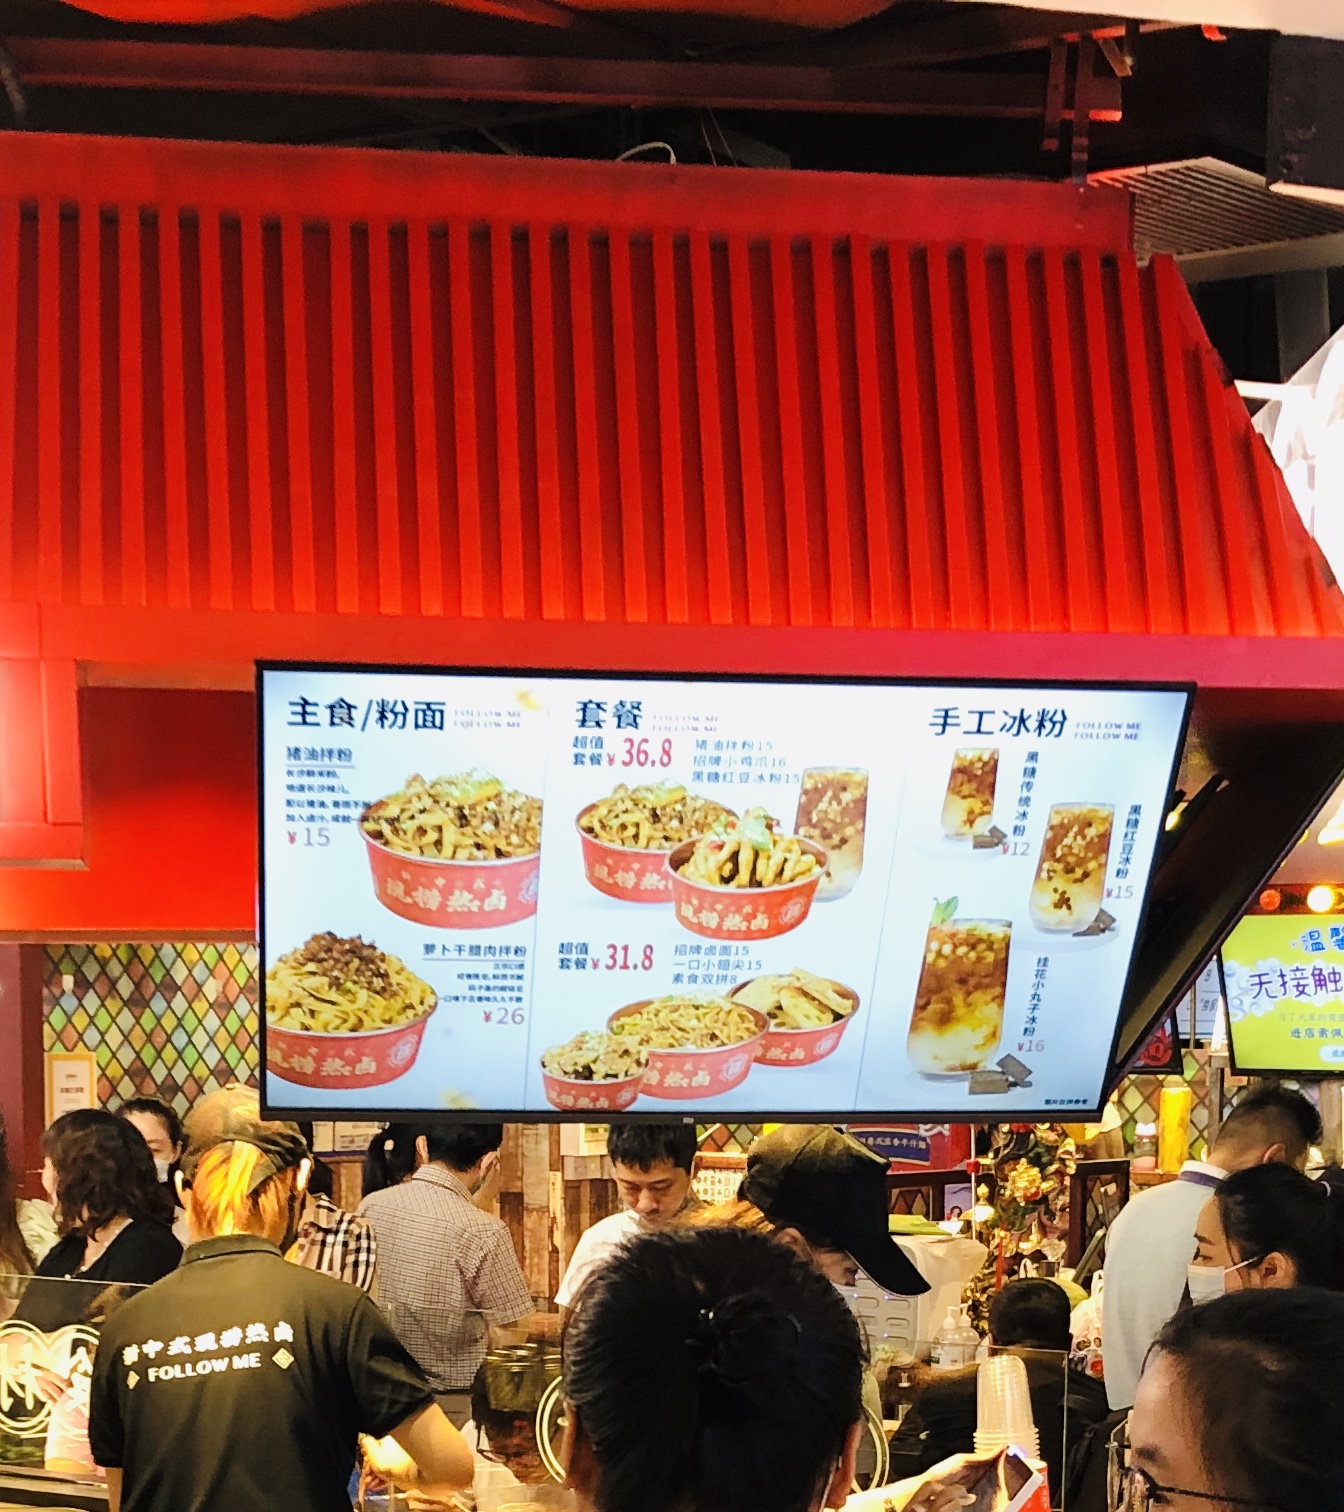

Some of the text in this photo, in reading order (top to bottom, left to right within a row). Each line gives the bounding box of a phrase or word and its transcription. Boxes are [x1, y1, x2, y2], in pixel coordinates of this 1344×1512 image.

[287, 696, 446, 732] 主食/粉面
[576, 699, 642, 729] 套餐
[929, 706, 1067, 738] 手工冰粉
[147, 1352, 262, 1382] FOLLOW ME
